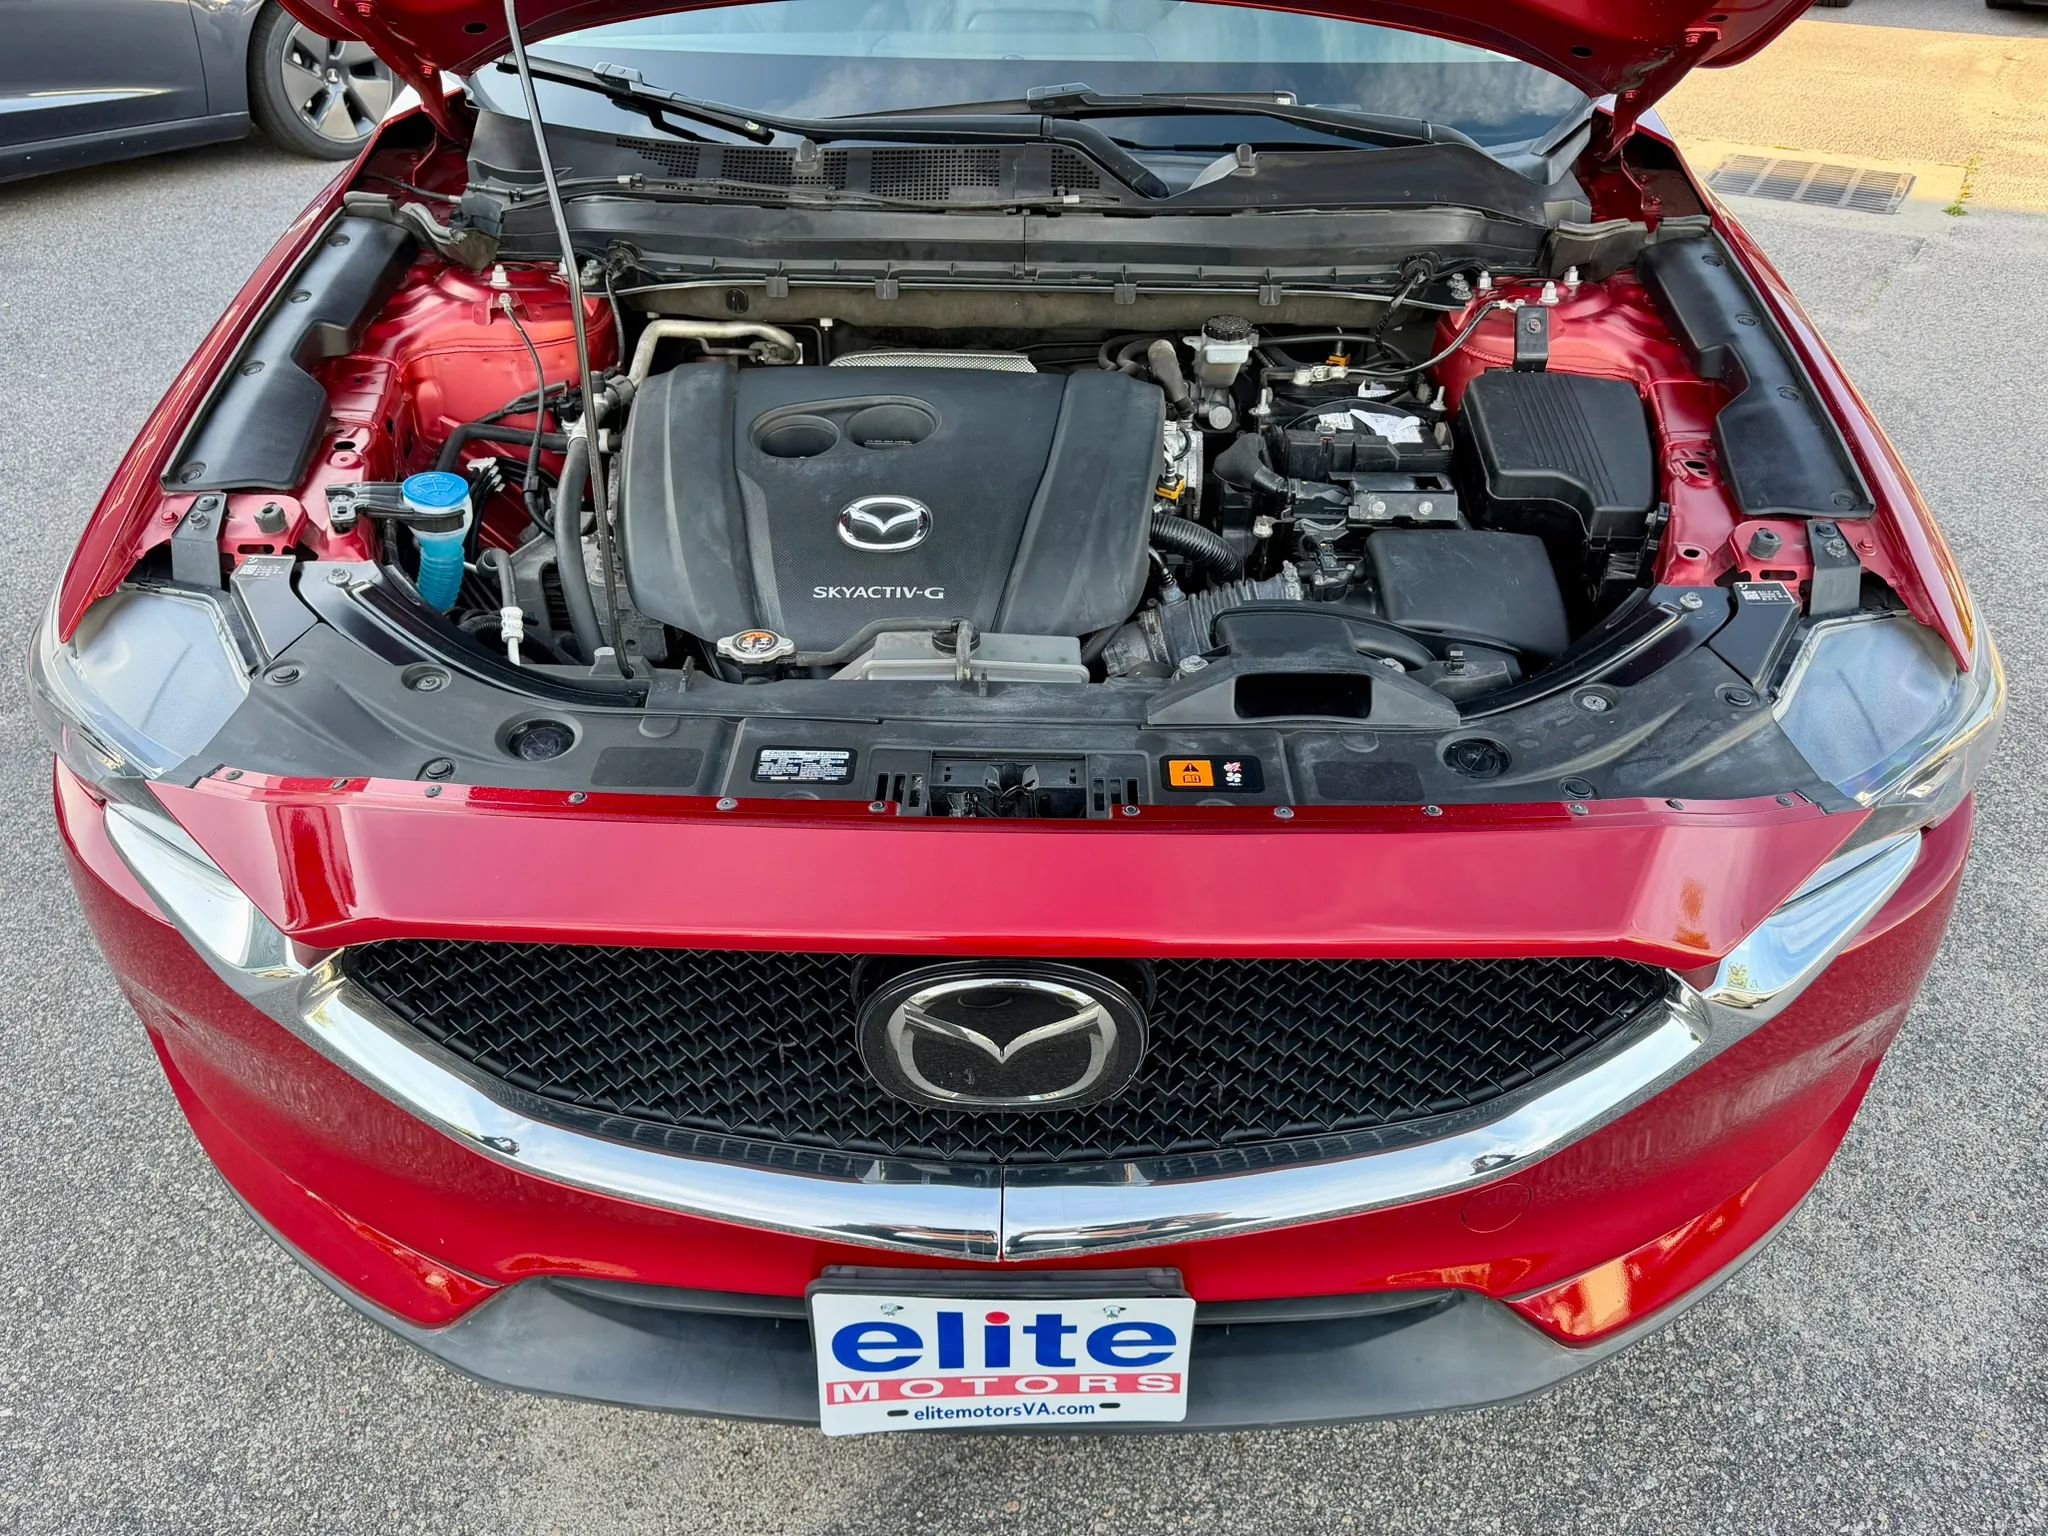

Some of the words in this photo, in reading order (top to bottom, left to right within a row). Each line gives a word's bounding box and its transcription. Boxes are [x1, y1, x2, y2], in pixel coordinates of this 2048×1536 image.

[812, 585, 945, 600] SKYACTIV-G
[831, 1311, 1177, 1373] elite
[833, 1374, 1176, 1403] MOTORS
[914, 1402, 1096, 1422] elitemotorsVA.com
